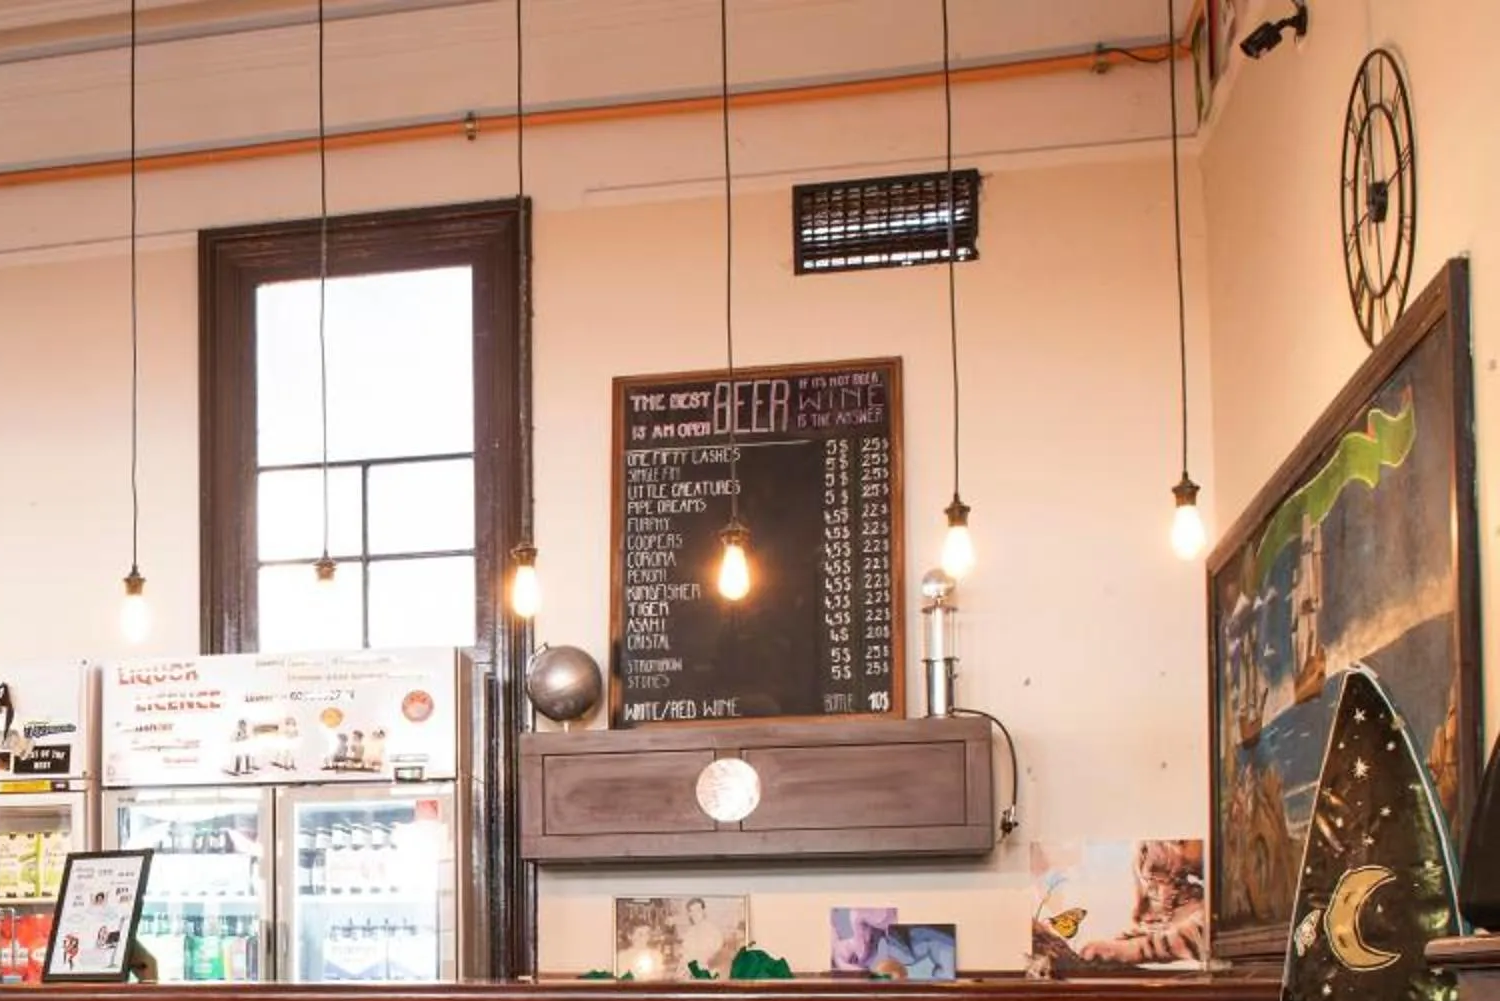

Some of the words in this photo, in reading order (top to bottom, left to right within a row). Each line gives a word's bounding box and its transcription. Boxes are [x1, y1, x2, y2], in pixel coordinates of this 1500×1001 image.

[799, 383, 884, 411] WINE
[630, 393, 666, 412] THE
[670, 391, 711, 409] BEST
[713, 379, 789, 434] BEER
[632, 426, 647, 440] IS
[652, 423, 675, 438] AN
[677, 421, 711, 438] OPEN
[690, 447, 741, 464] LASHES
[627, 483, 669, 500] LITTLE
[671, 480, 741, 497] CREATURES
[657, 499, 707, 513] DREAMS
[627, 533, 683, 550] COOPERS
[627, 551, 677, 568] CORONA
[627, 601, 669, 616] TIGER
[627, 617, 665, 632] ASAHI
[702, 697, 742, 717] WINE
